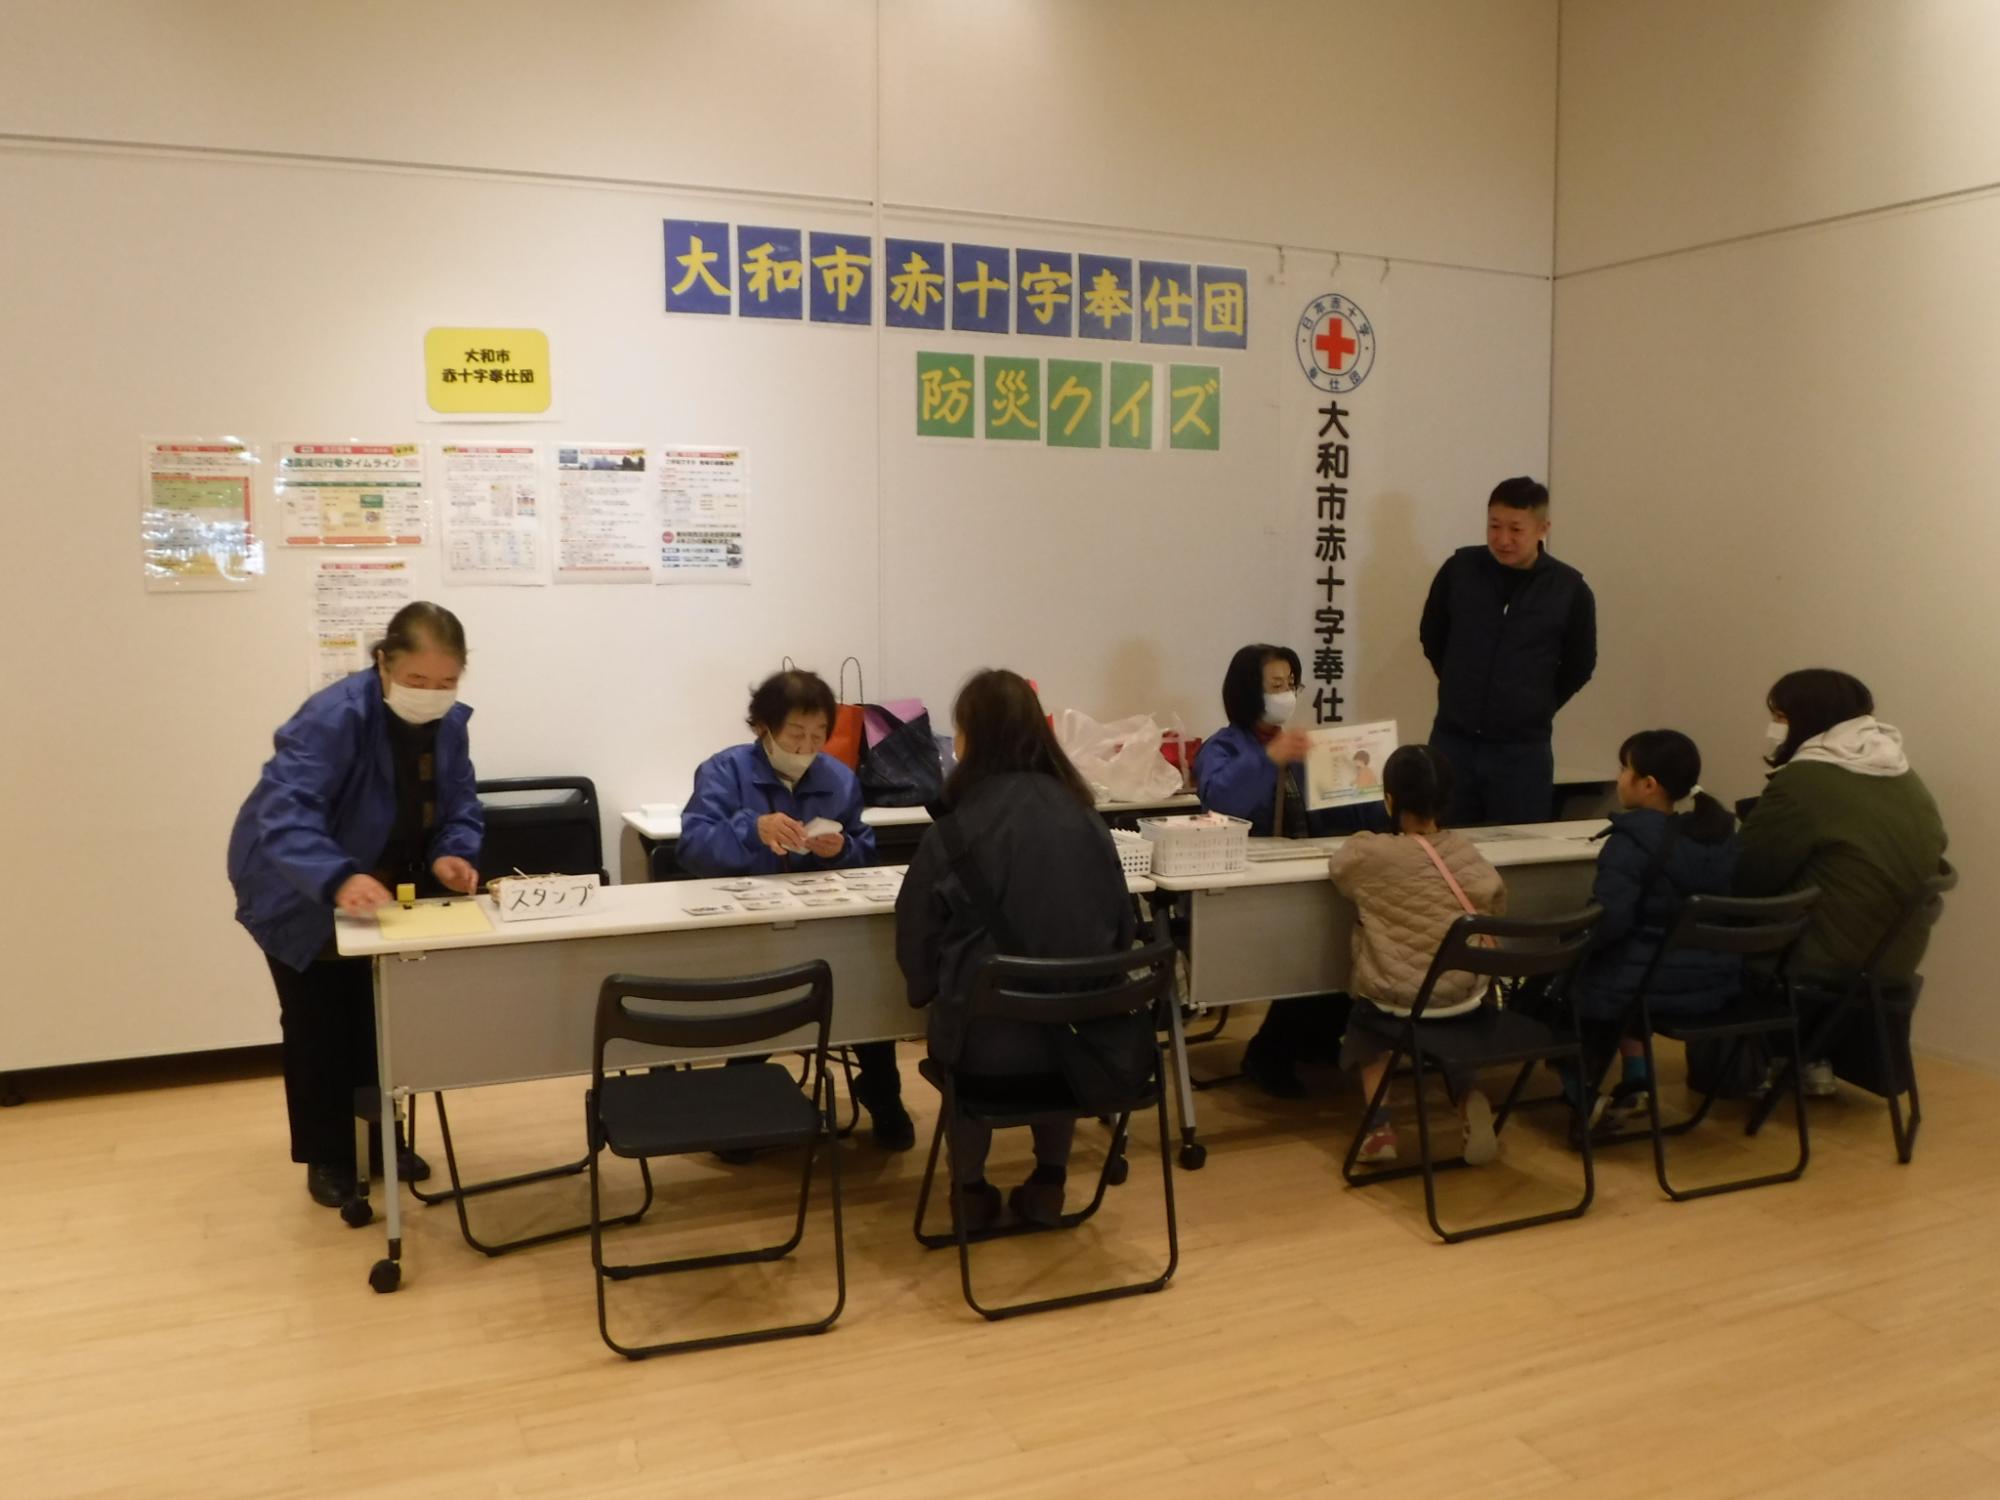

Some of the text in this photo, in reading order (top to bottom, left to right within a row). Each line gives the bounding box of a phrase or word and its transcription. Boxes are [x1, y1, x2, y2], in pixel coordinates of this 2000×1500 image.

[671, 235, 1245, 336] 大和市赤十字奉仕団
[464, 348, 511, 363] 大和市
[442, 368, 534, 383] 赤十字奉仕団
[920, 366, 1219, 437] 防災クイズ
[510, 882, 594, 911] スタンプ
